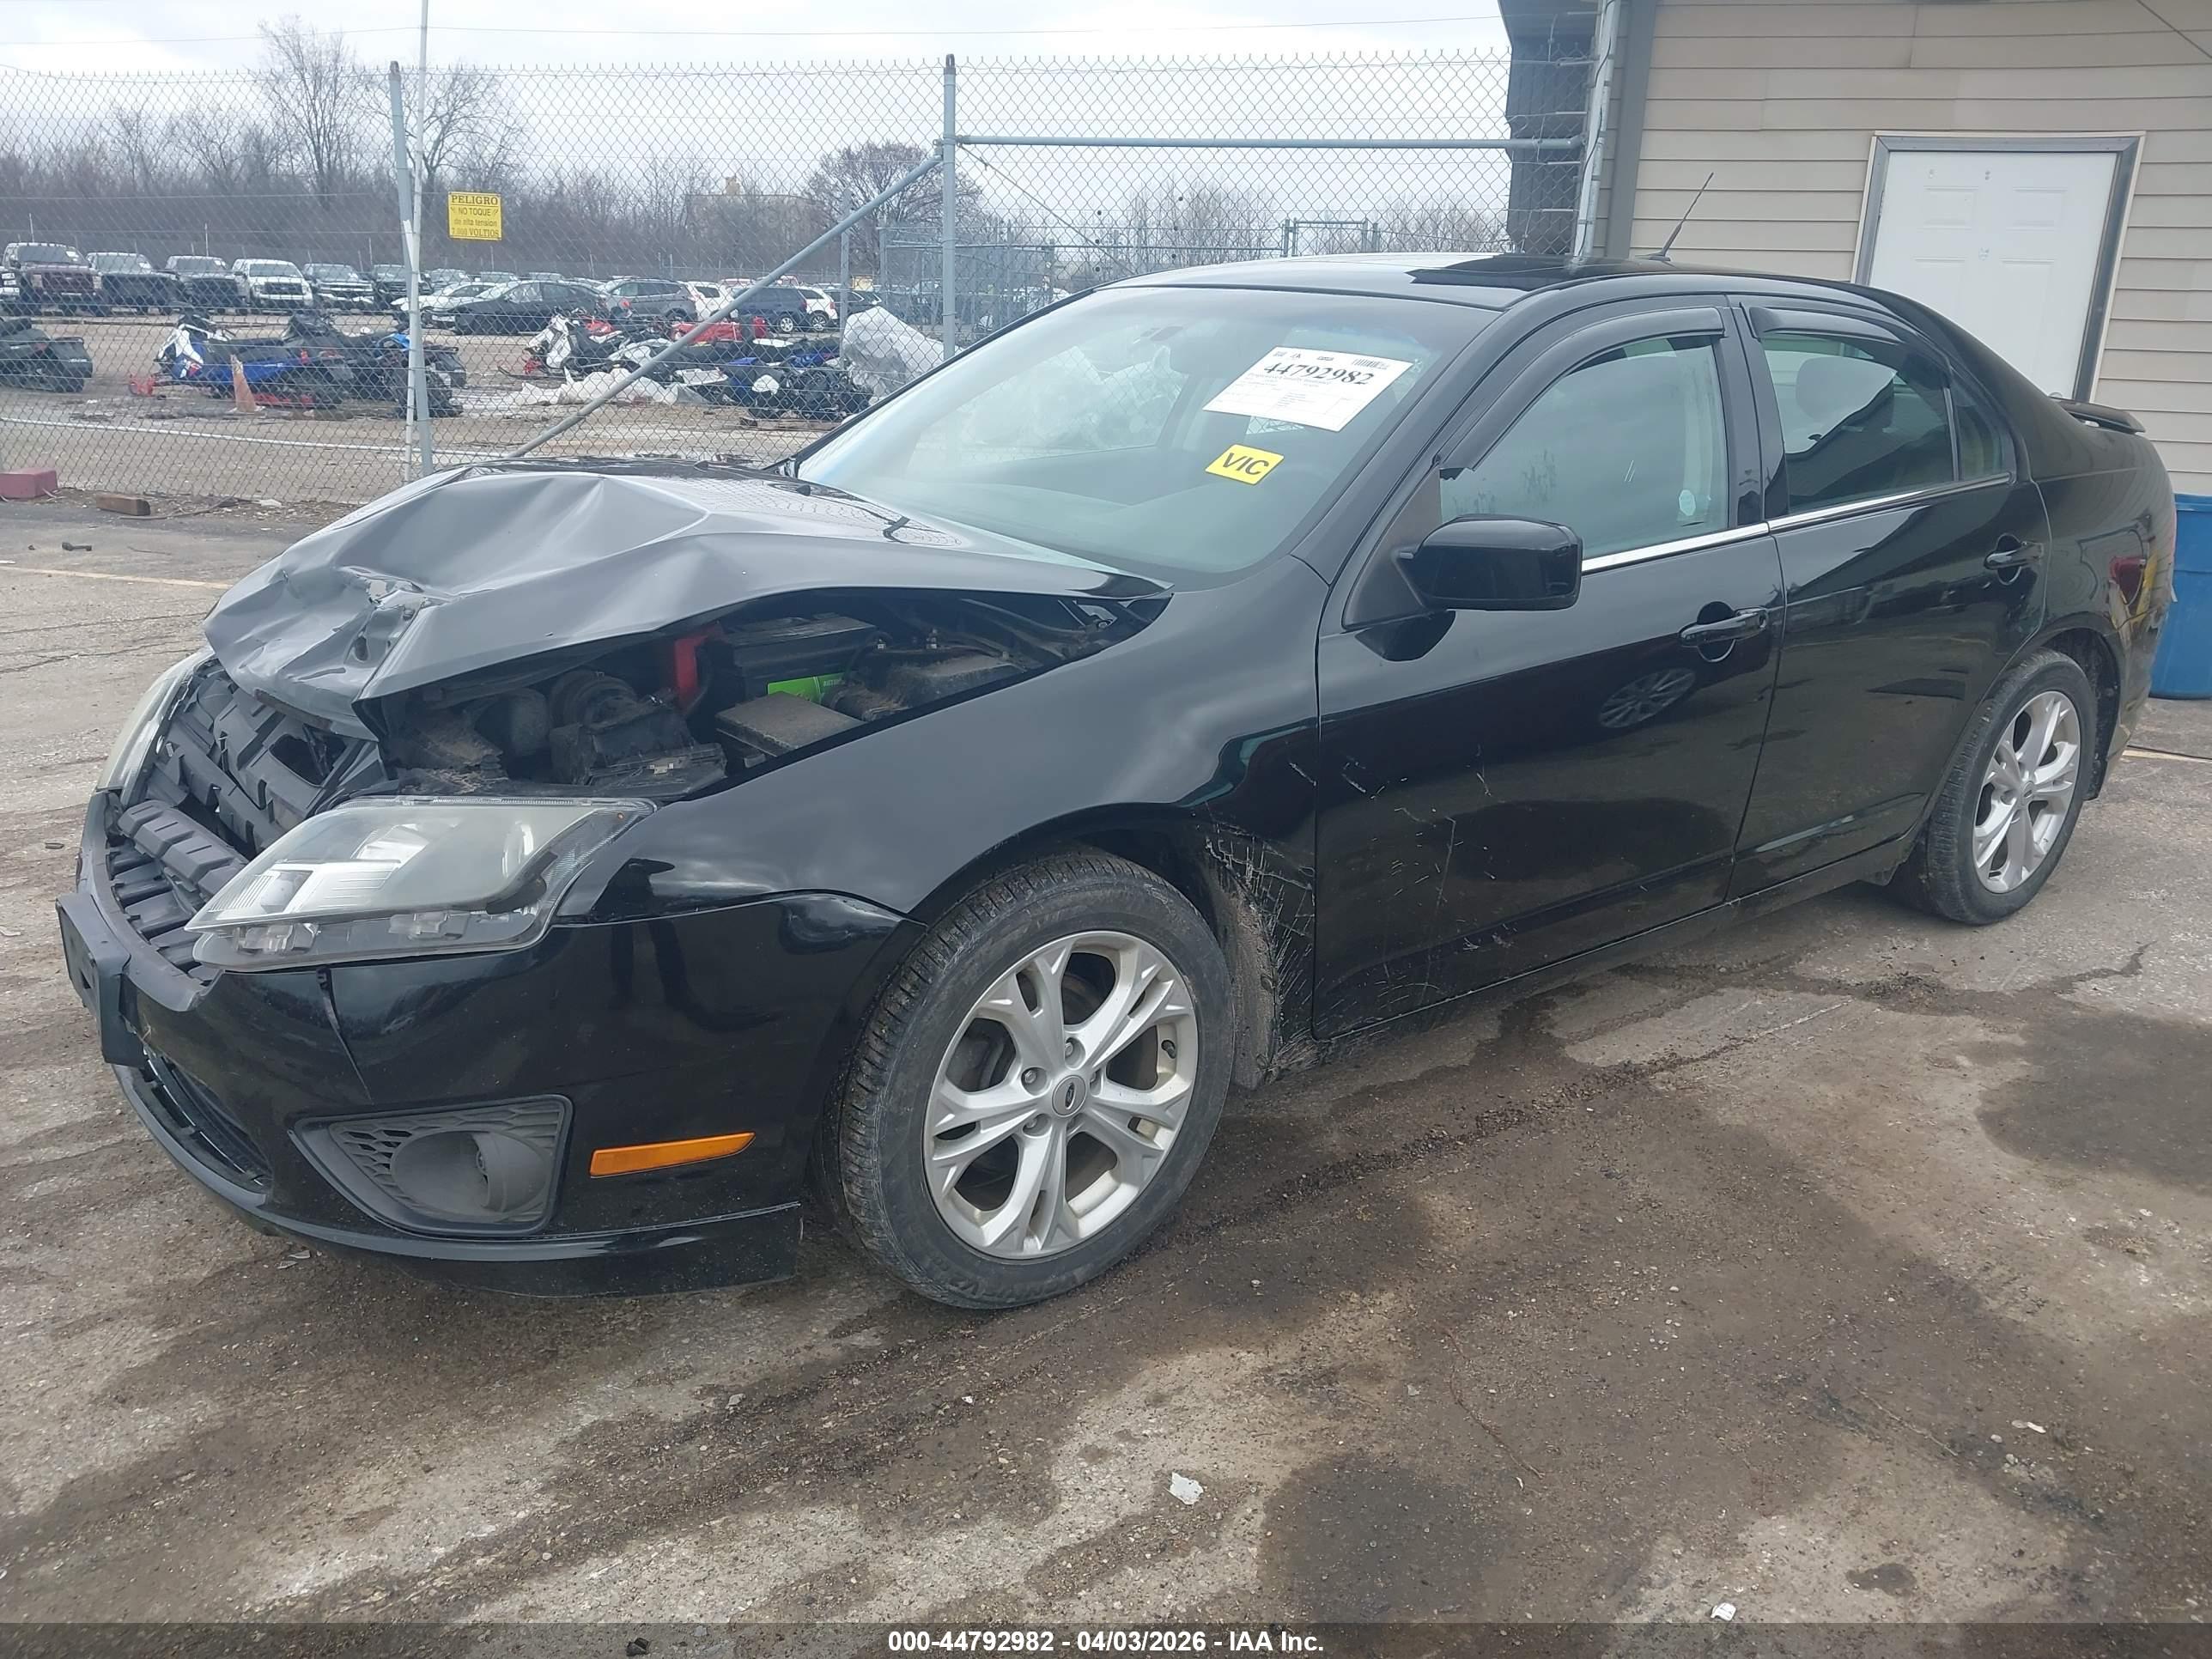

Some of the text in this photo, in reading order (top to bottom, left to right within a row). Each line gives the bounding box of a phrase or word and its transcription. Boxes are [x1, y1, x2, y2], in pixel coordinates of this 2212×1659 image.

[452, 195, 498, 205] PELIGRO
[459, 207, 492, 216] NO TOQUE
[469, 228, 500, 237] VOLTIOS
[1263, 362, 1375, 386] 44792982
[1222, 453, 1269, 476] VIC
